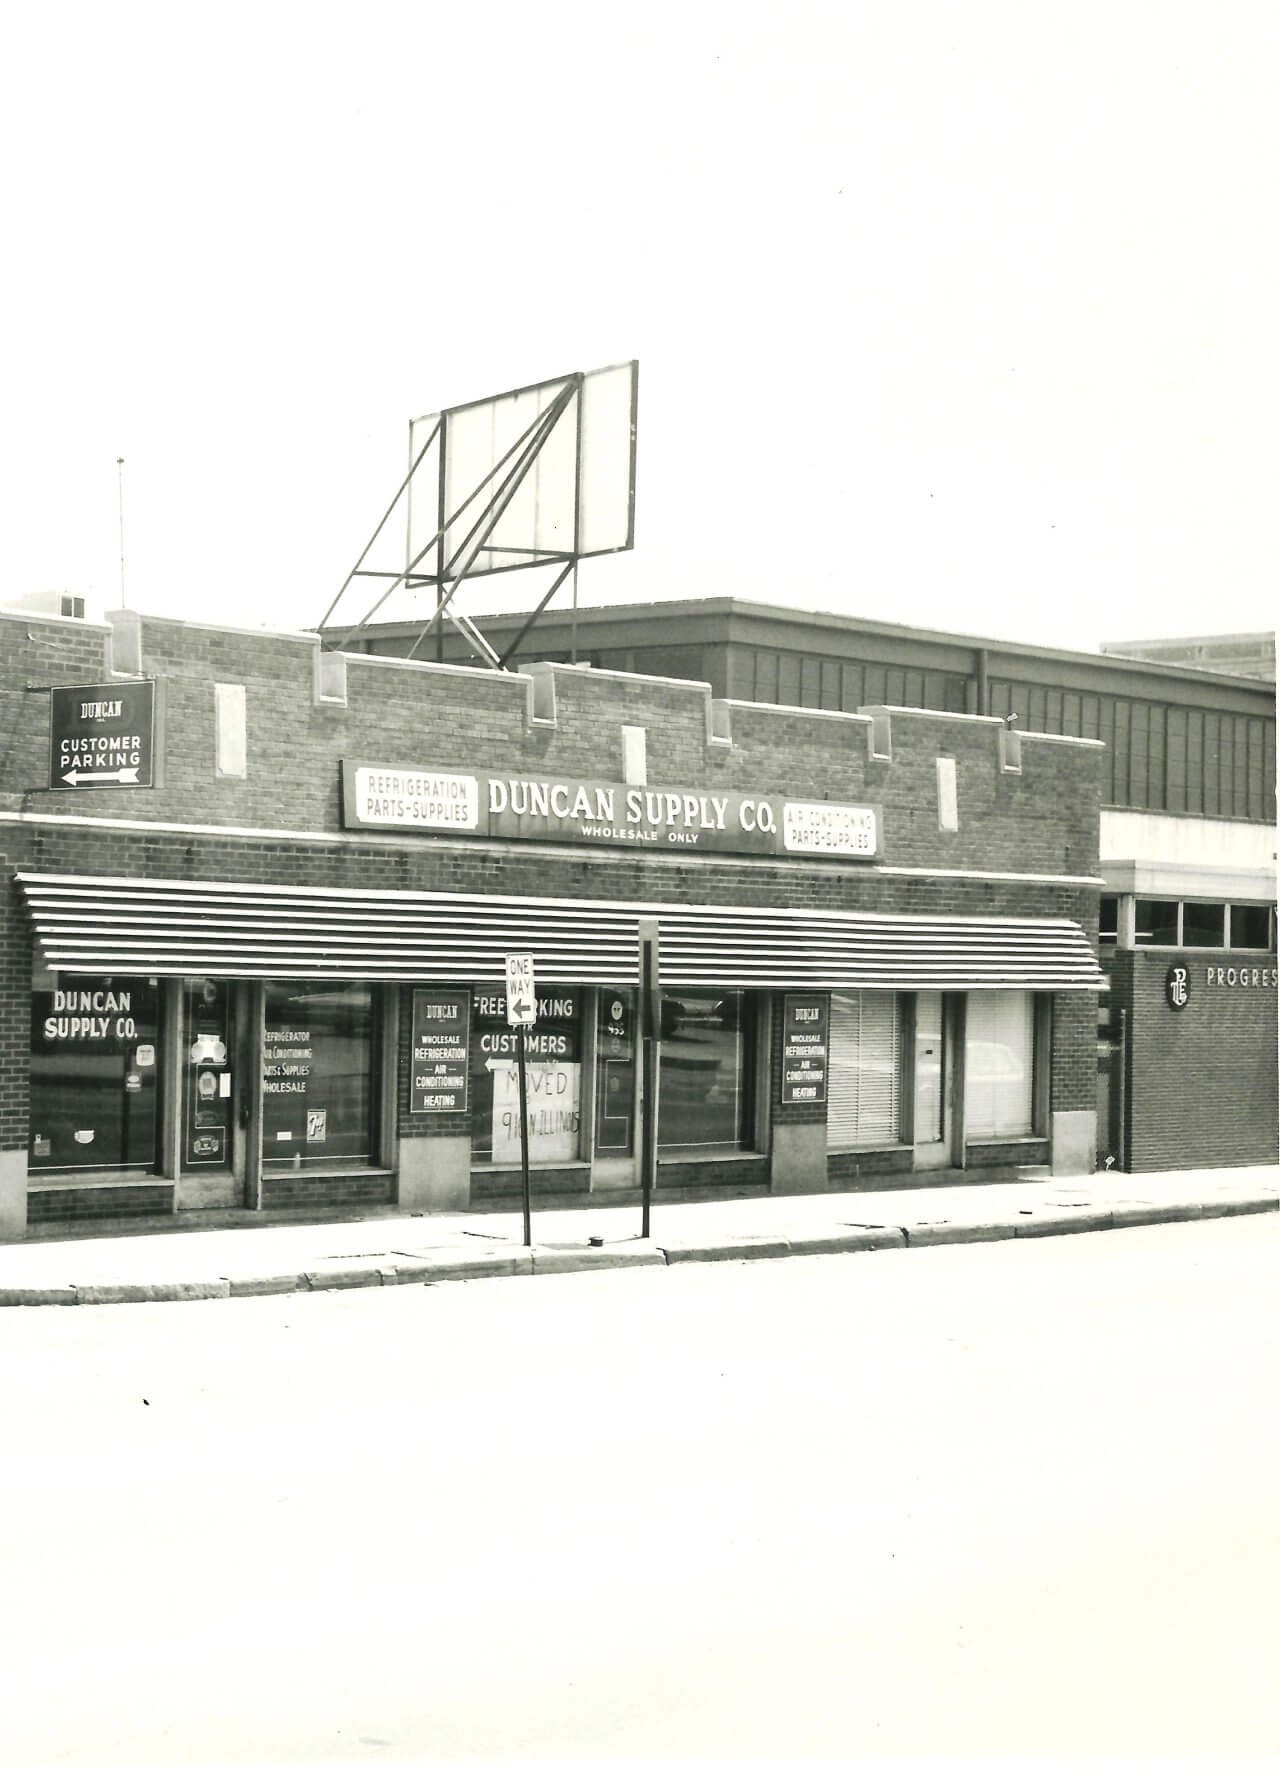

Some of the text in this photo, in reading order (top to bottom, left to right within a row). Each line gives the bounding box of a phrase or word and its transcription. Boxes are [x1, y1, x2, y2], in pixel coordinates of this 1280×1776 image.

[80, 701, 123, 719] DUNCAN
[60, 736, 141, 752] CUSTOMER
[60, 752, 140, 768] PARKING
[368, 775, 467, 800] REFRIGERATION
[367, 798, 468, 822] PARTS-SUPPLIES
[488, 779, 777, 834] DUNCAN SUPPLY CO.
[581, 825, 698, 844] WHOLESALE ONLY
[510, 959, 529, 975] ONE
[510, 979, 530, 995] WAY
[53, 991, 131, 1012] DUNCAN
[426, 1005, 458, 1019] DUNCAN
[44, 1017, 138, 1038] SUPPLY CO.
[422, 1035, 460, 1044] WHOLESALE
[415, 1048, 466, 1060] REFRIGERATION
[434, 1064, 447, 1074] AIR
[415, 1076, 465, 1088] CONDITIONING
[506, 1071, 568, 1096] MVED
[423, 1095, 455, 1107] HEATING
